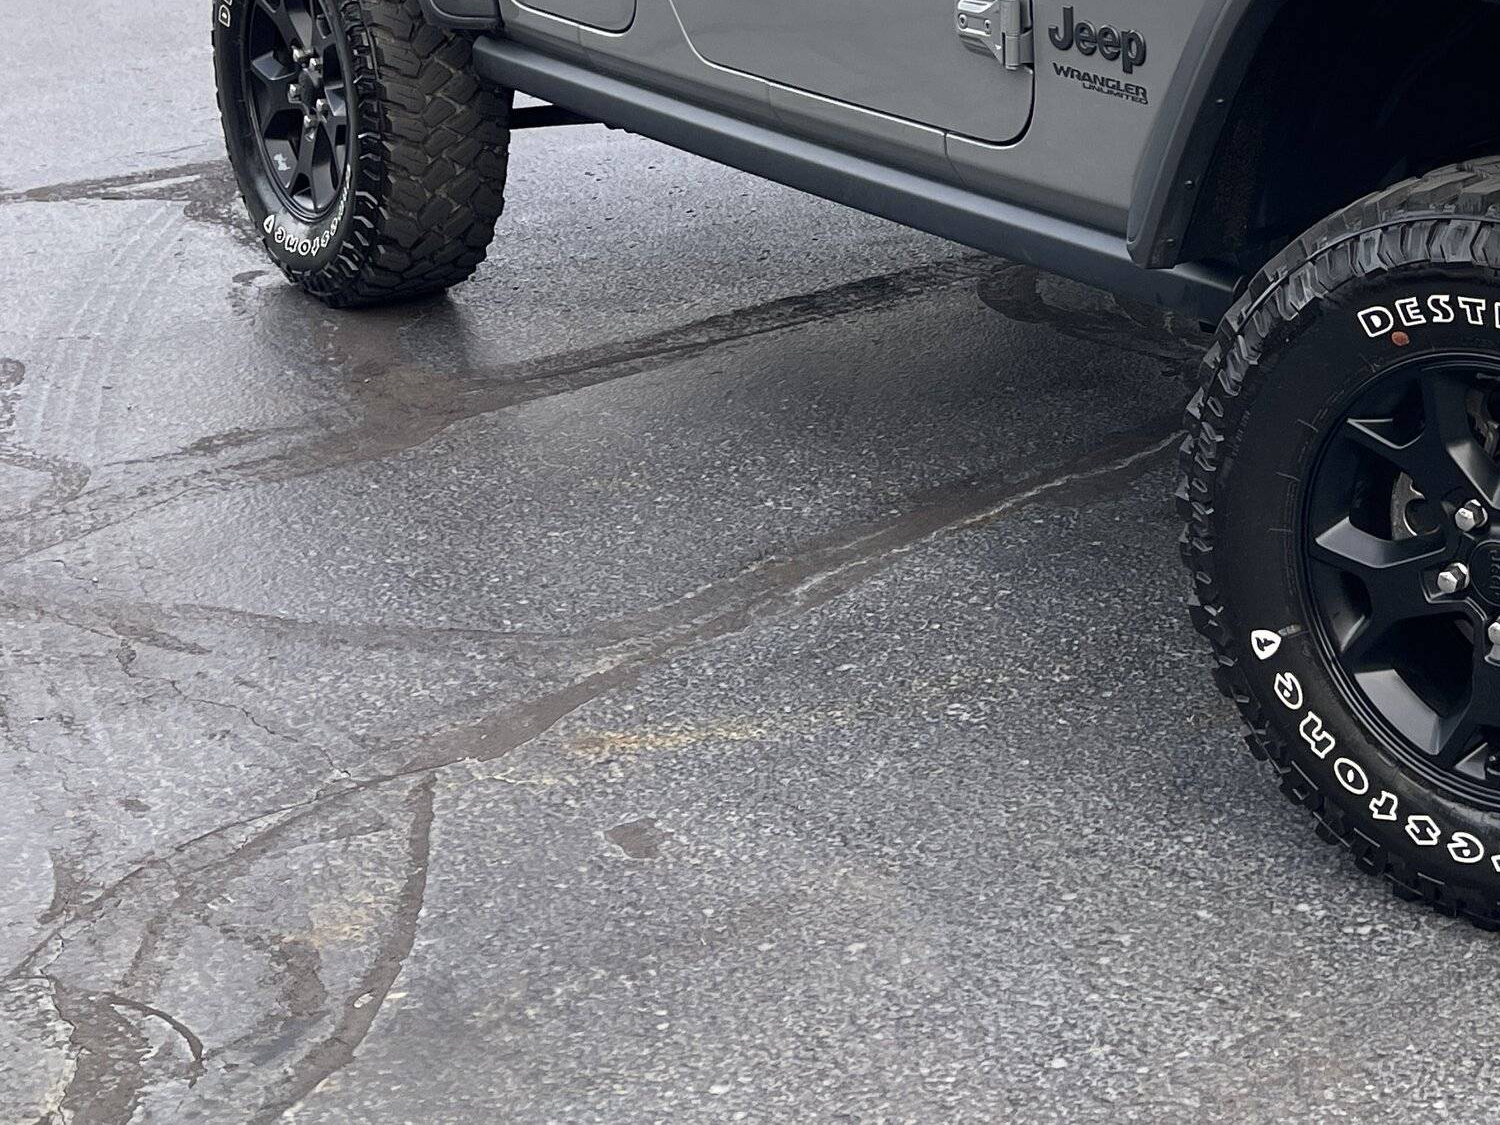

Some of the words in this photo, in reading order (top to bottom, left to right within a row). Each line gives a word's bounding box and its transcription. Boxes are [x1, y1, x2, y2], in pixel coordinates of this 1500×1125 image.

[1047, 5, 1147, 75] Jeep
[1052, 62, 1148, 100] WRANGLER
[1082, 82, 1149, 105] UNLIMITED
